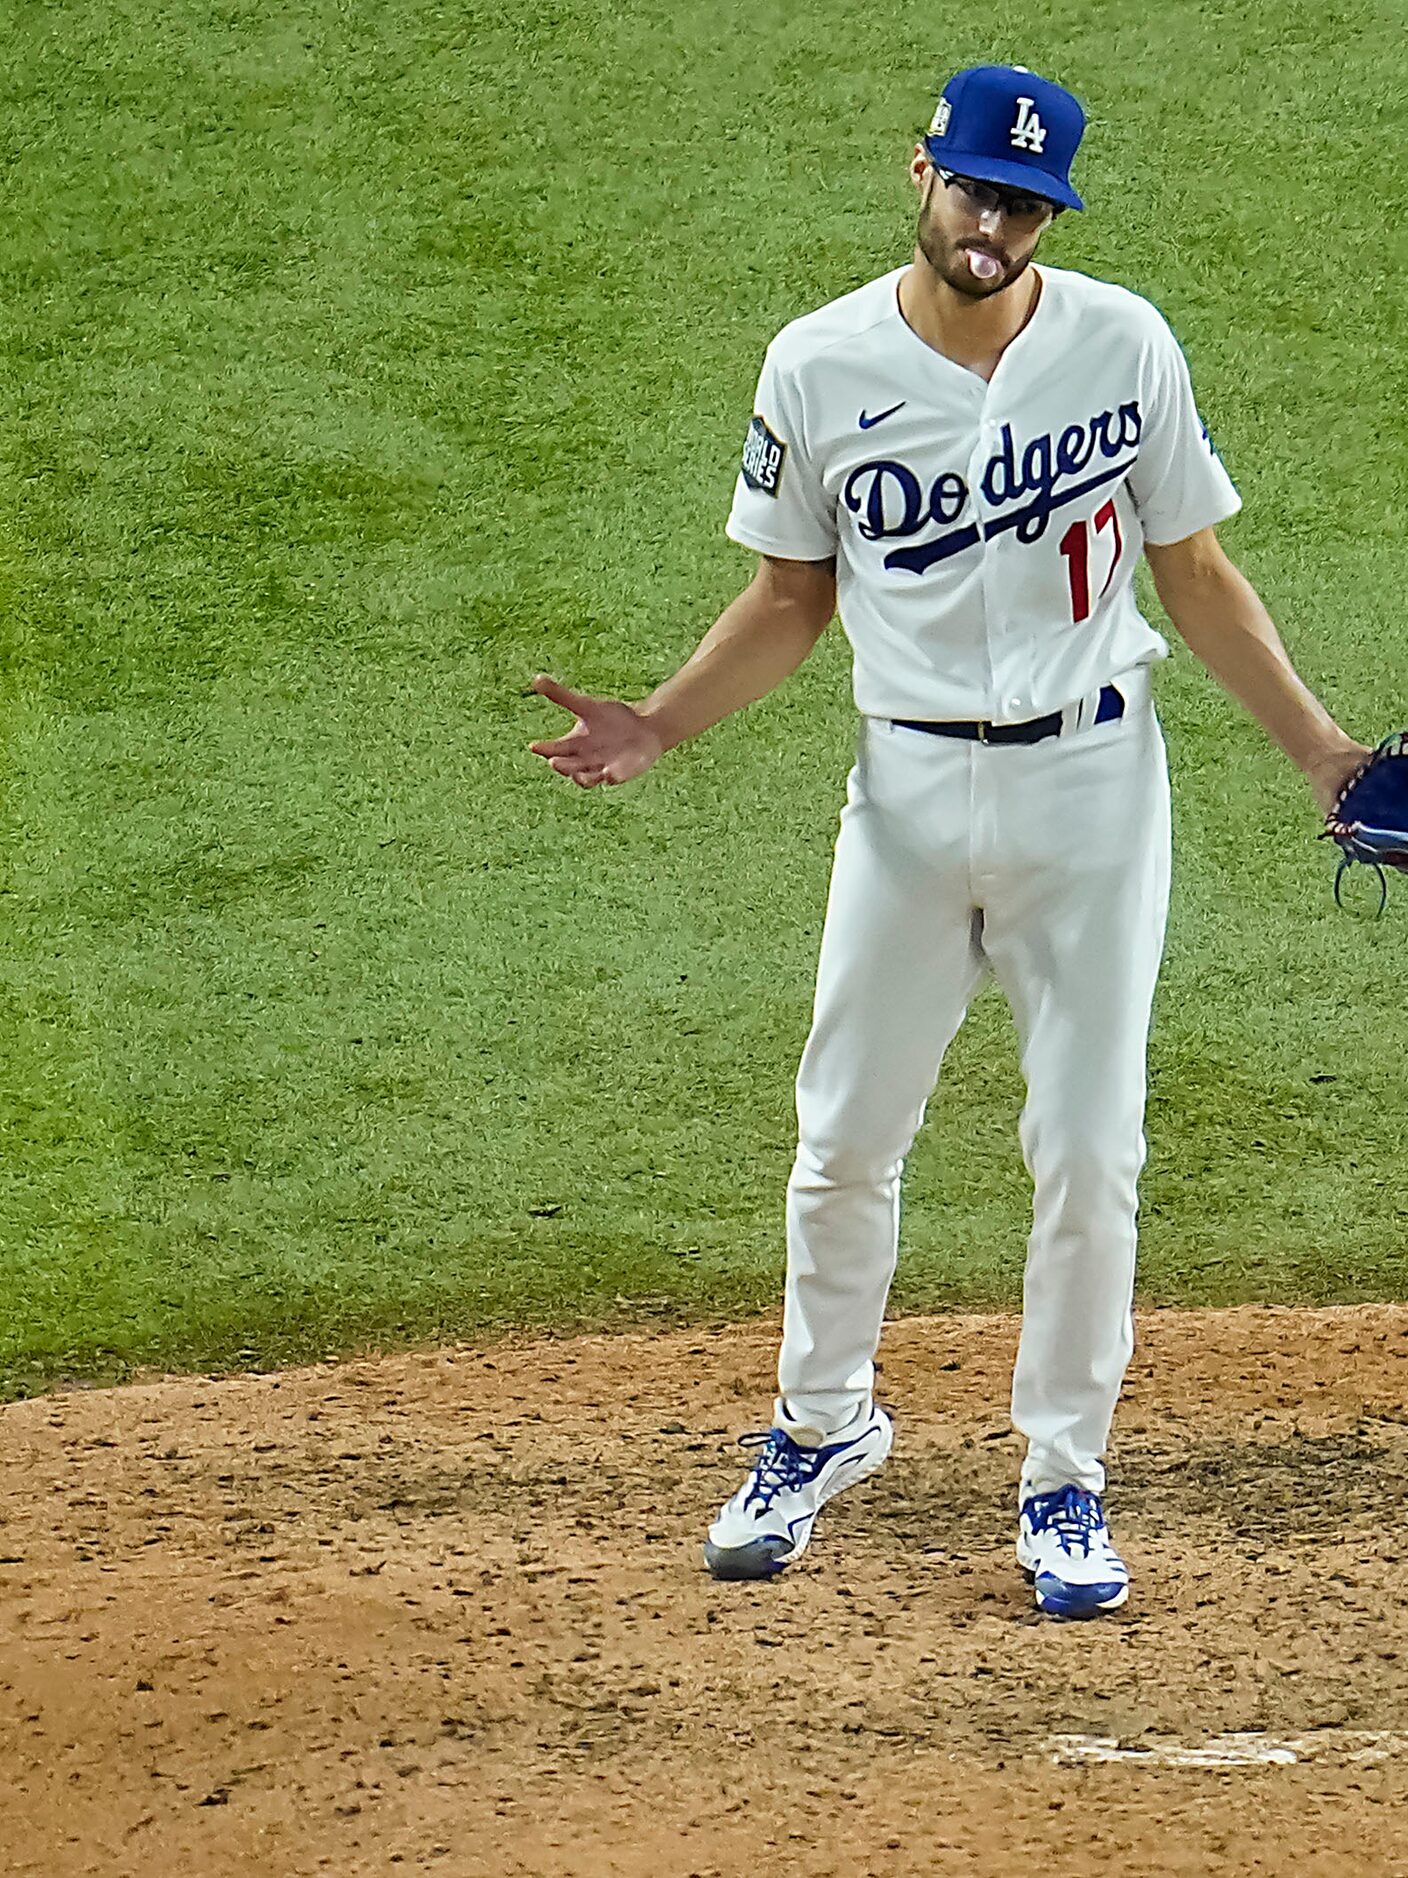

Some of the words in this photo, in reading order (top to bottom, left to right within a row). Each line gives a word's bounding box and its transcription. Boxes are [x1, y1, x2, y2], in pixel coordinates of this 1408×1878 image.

[1010, 97, 1047, 153] LA
[745, 422, 781, 468] RLD
[844, 400, 1143, 545] Dodgers
[1059, 498, 1122, 624] 17
